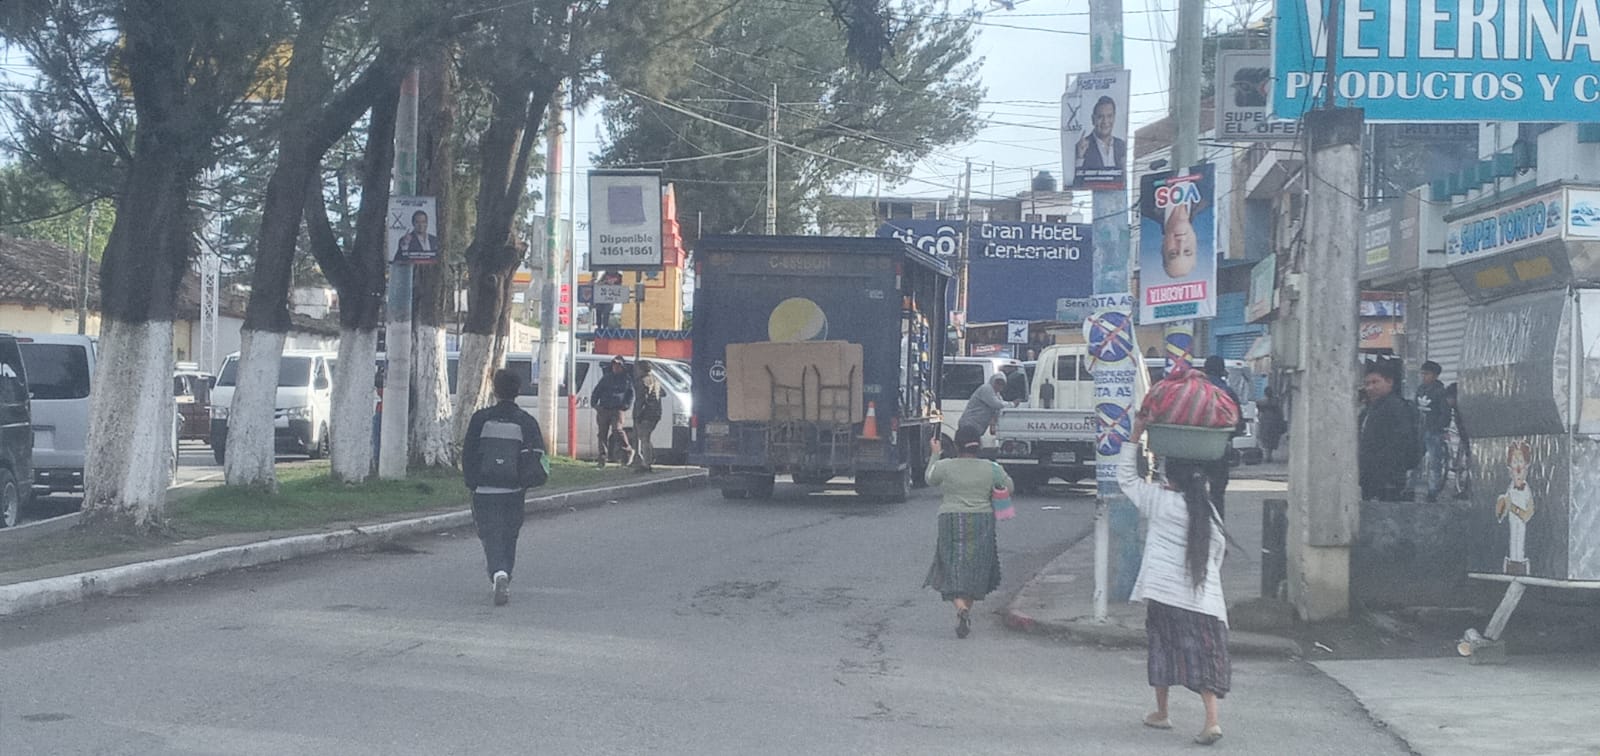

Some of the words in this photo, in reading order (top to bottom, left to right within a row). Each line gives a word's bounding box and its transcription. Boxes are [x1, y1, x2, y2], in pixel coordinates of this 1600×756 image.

[1286, 71, 1524, 101] PRODUCTOS
[1536, 74, 1561, 101] Y
[1224, 111, 1266, 122] SUPE
[1224, 122, 1248, 133] EL
[1155, 181, 1201, 208] VOS
[981, 223, 1023, 240] Gran
[1460, 216, 1498, 255] SUPER
[1498, 200, 1546, 246] TORITO
[599, 234, 653, 245] Disponible
[599, 246, 653, 256] 4161-1861
[984, 242, 1080, 261] Centenario
[1149, 283, 1204, 303] VILLACORTA
[1027, 422, 1047, 430] KIA
